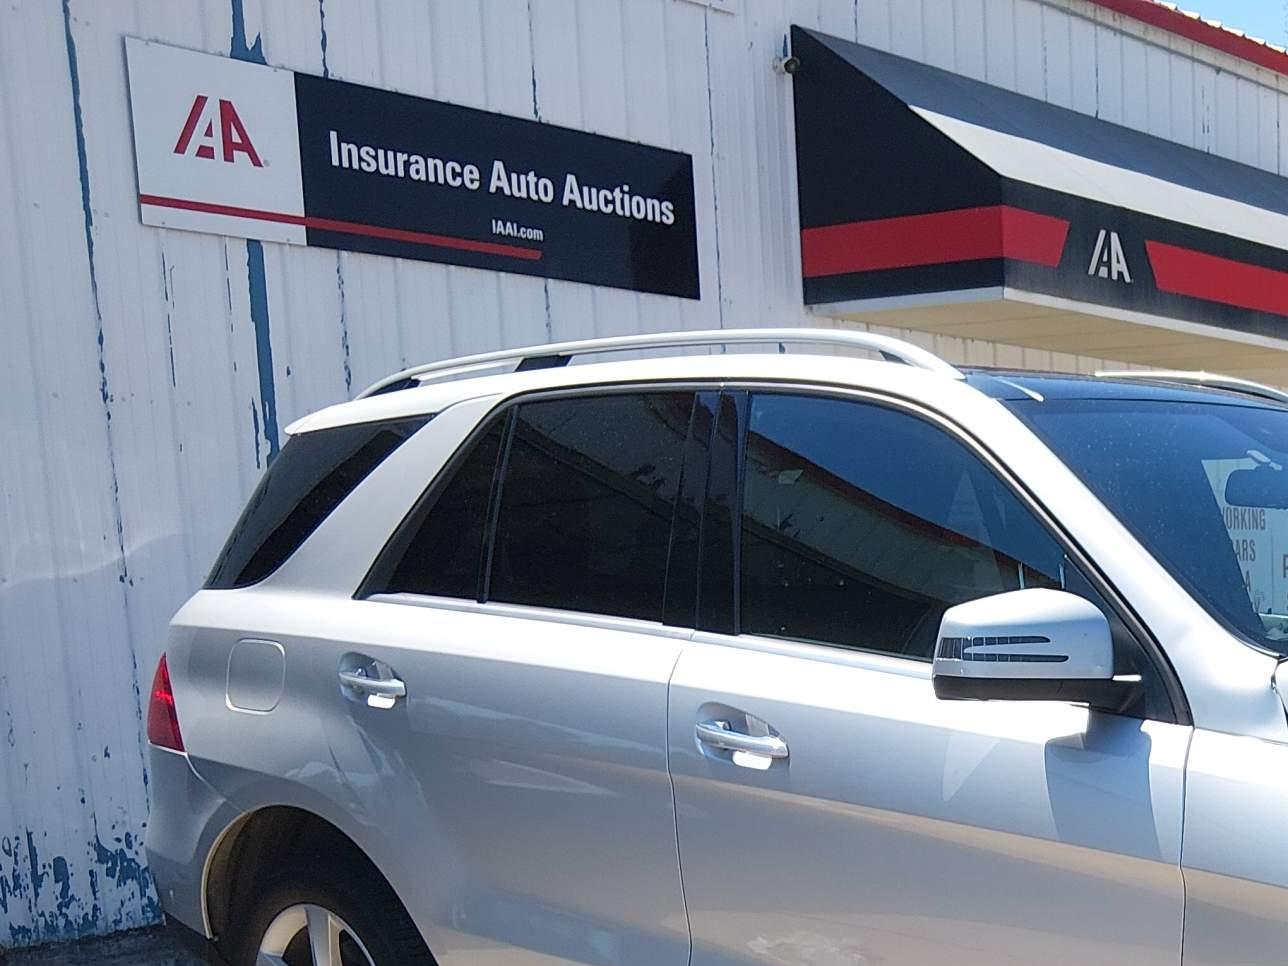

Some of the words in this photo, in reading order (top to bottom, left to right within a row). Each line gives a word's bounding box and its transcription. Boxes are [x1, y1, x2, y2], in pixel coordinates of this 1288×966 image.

[329, 130, 481, 191] Insurance
[489, 159, 555, 203] Auto
[562, 173, 676, 226] Auctions
[491, 218, 544, 242] IAAI.com
[1223, 506, 1266, 530] ORKING
[1233, 538, 1256, 562] ARS
